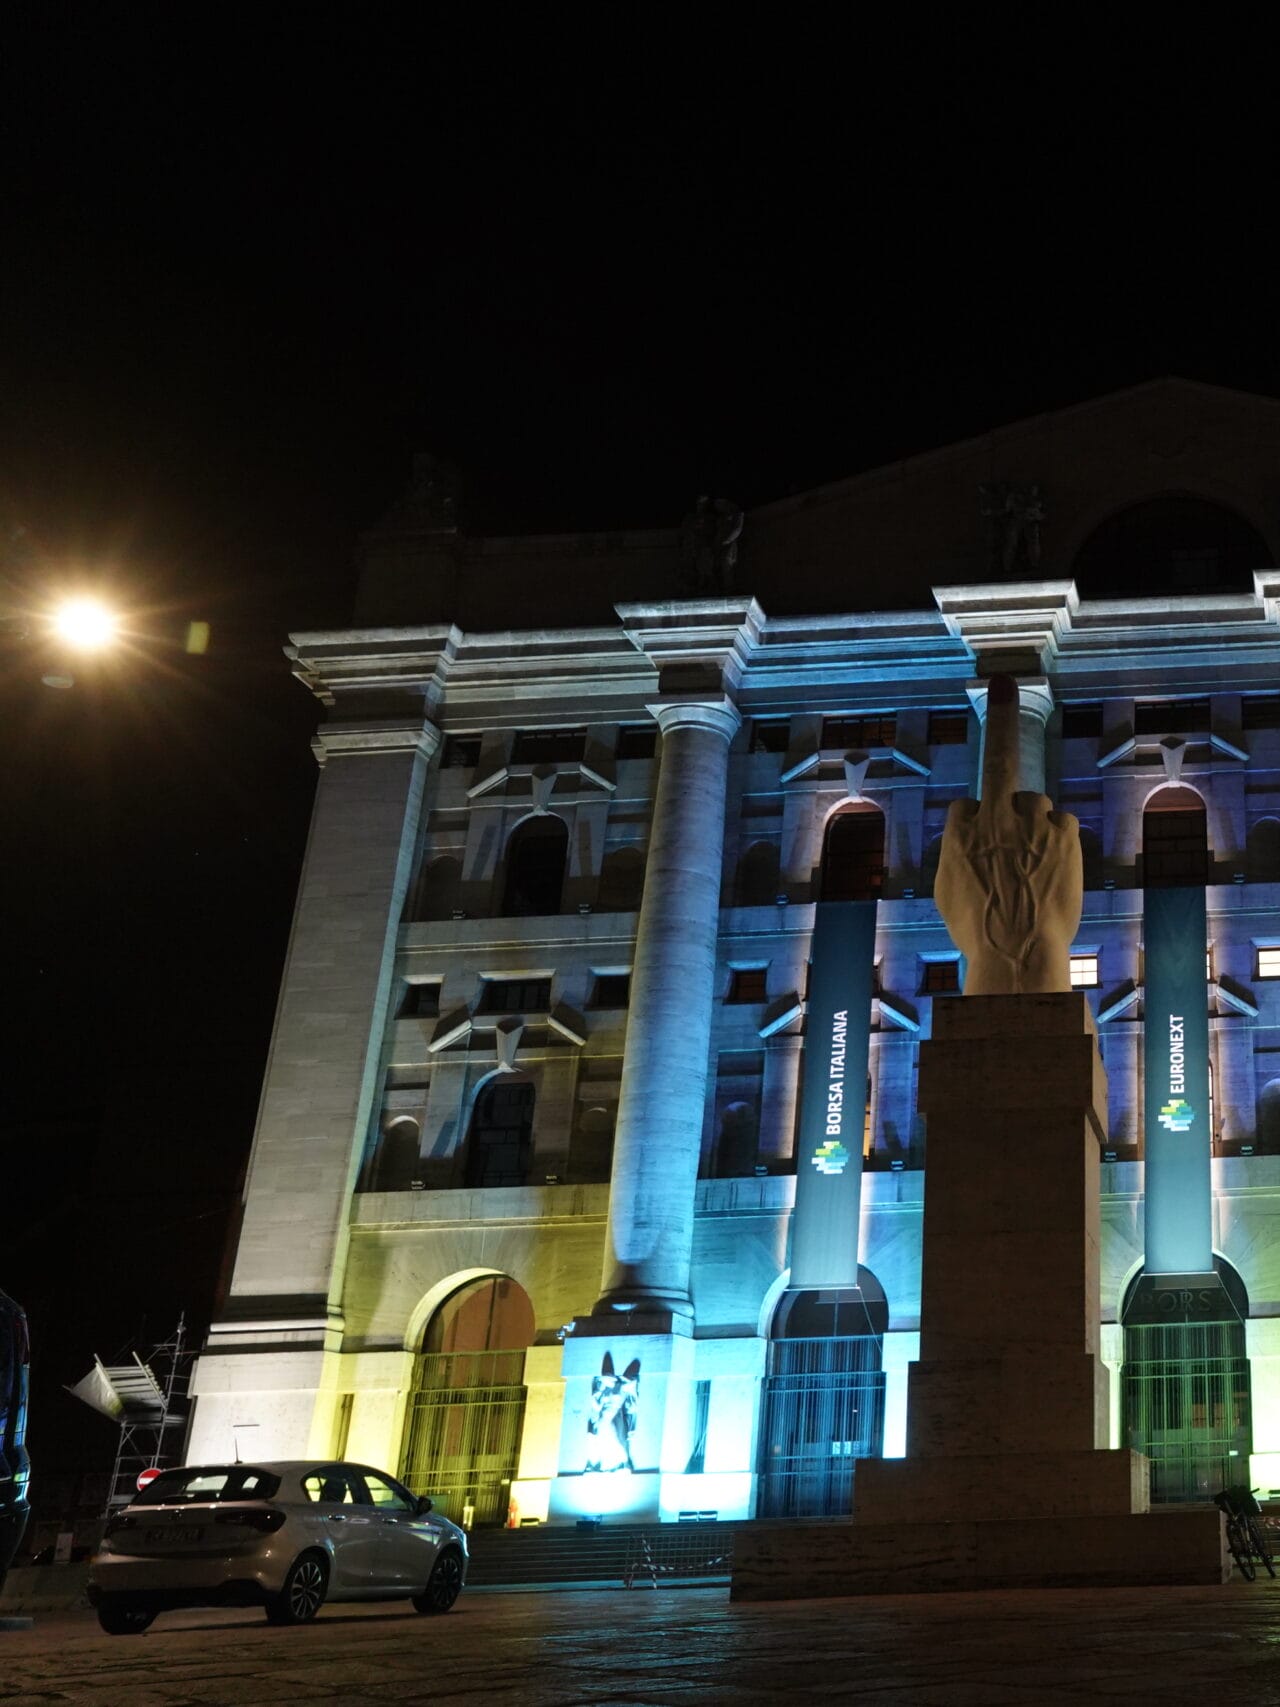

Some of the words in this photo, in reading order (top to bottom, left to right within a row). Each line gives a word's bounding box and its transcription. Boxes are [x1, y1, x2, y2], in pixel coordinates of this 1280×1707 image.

[829, 1010, 848, 1079] ITALIANA
[1169, 1014, 1185, 1094] EURONEXT
[826, 1081, 844, 1135] BORSA
[1139, 1290, 1230, 1313] ORS
